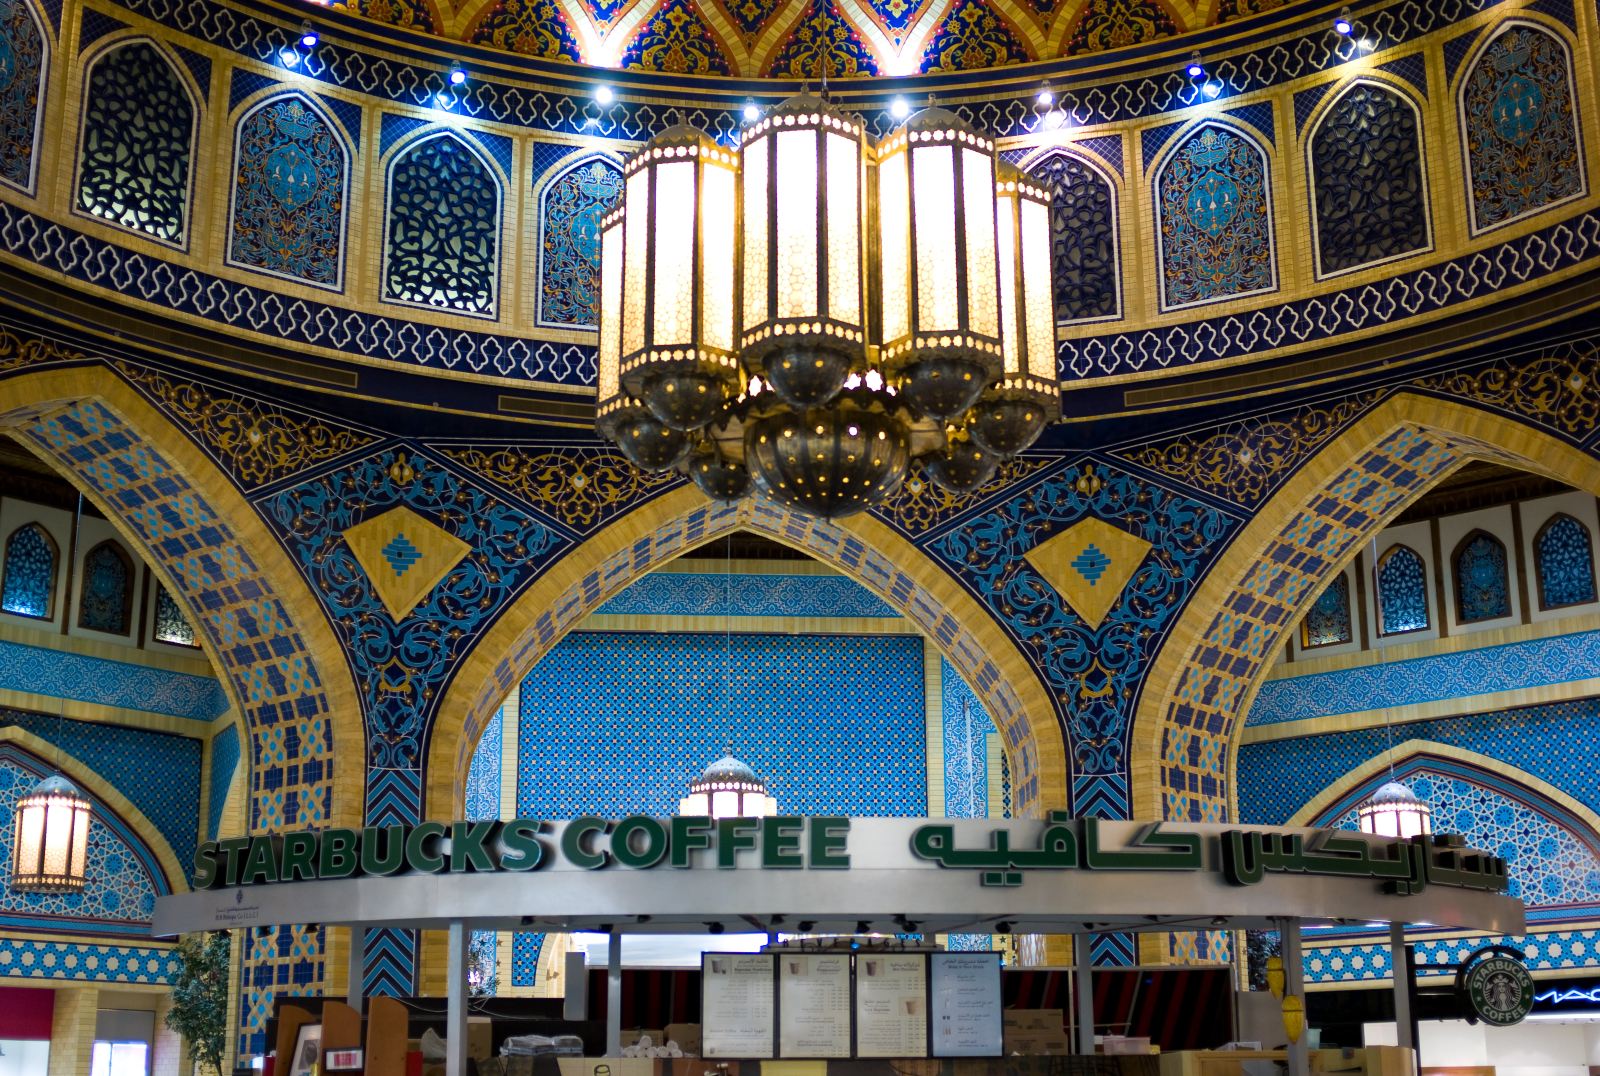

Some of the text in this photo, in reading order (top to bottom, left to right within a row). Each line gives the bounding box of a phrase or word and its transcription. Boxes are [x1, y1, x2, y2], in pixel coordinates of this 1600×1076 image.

[193, 815, 851, 890] STARBUCKS COFFEE
[910, 810, 1508, 895] ستاربكس كافيه
[1473, 961, 1530, 989] STARBUCKS
[1483, 1004, 1526, 1021] COFFEE
